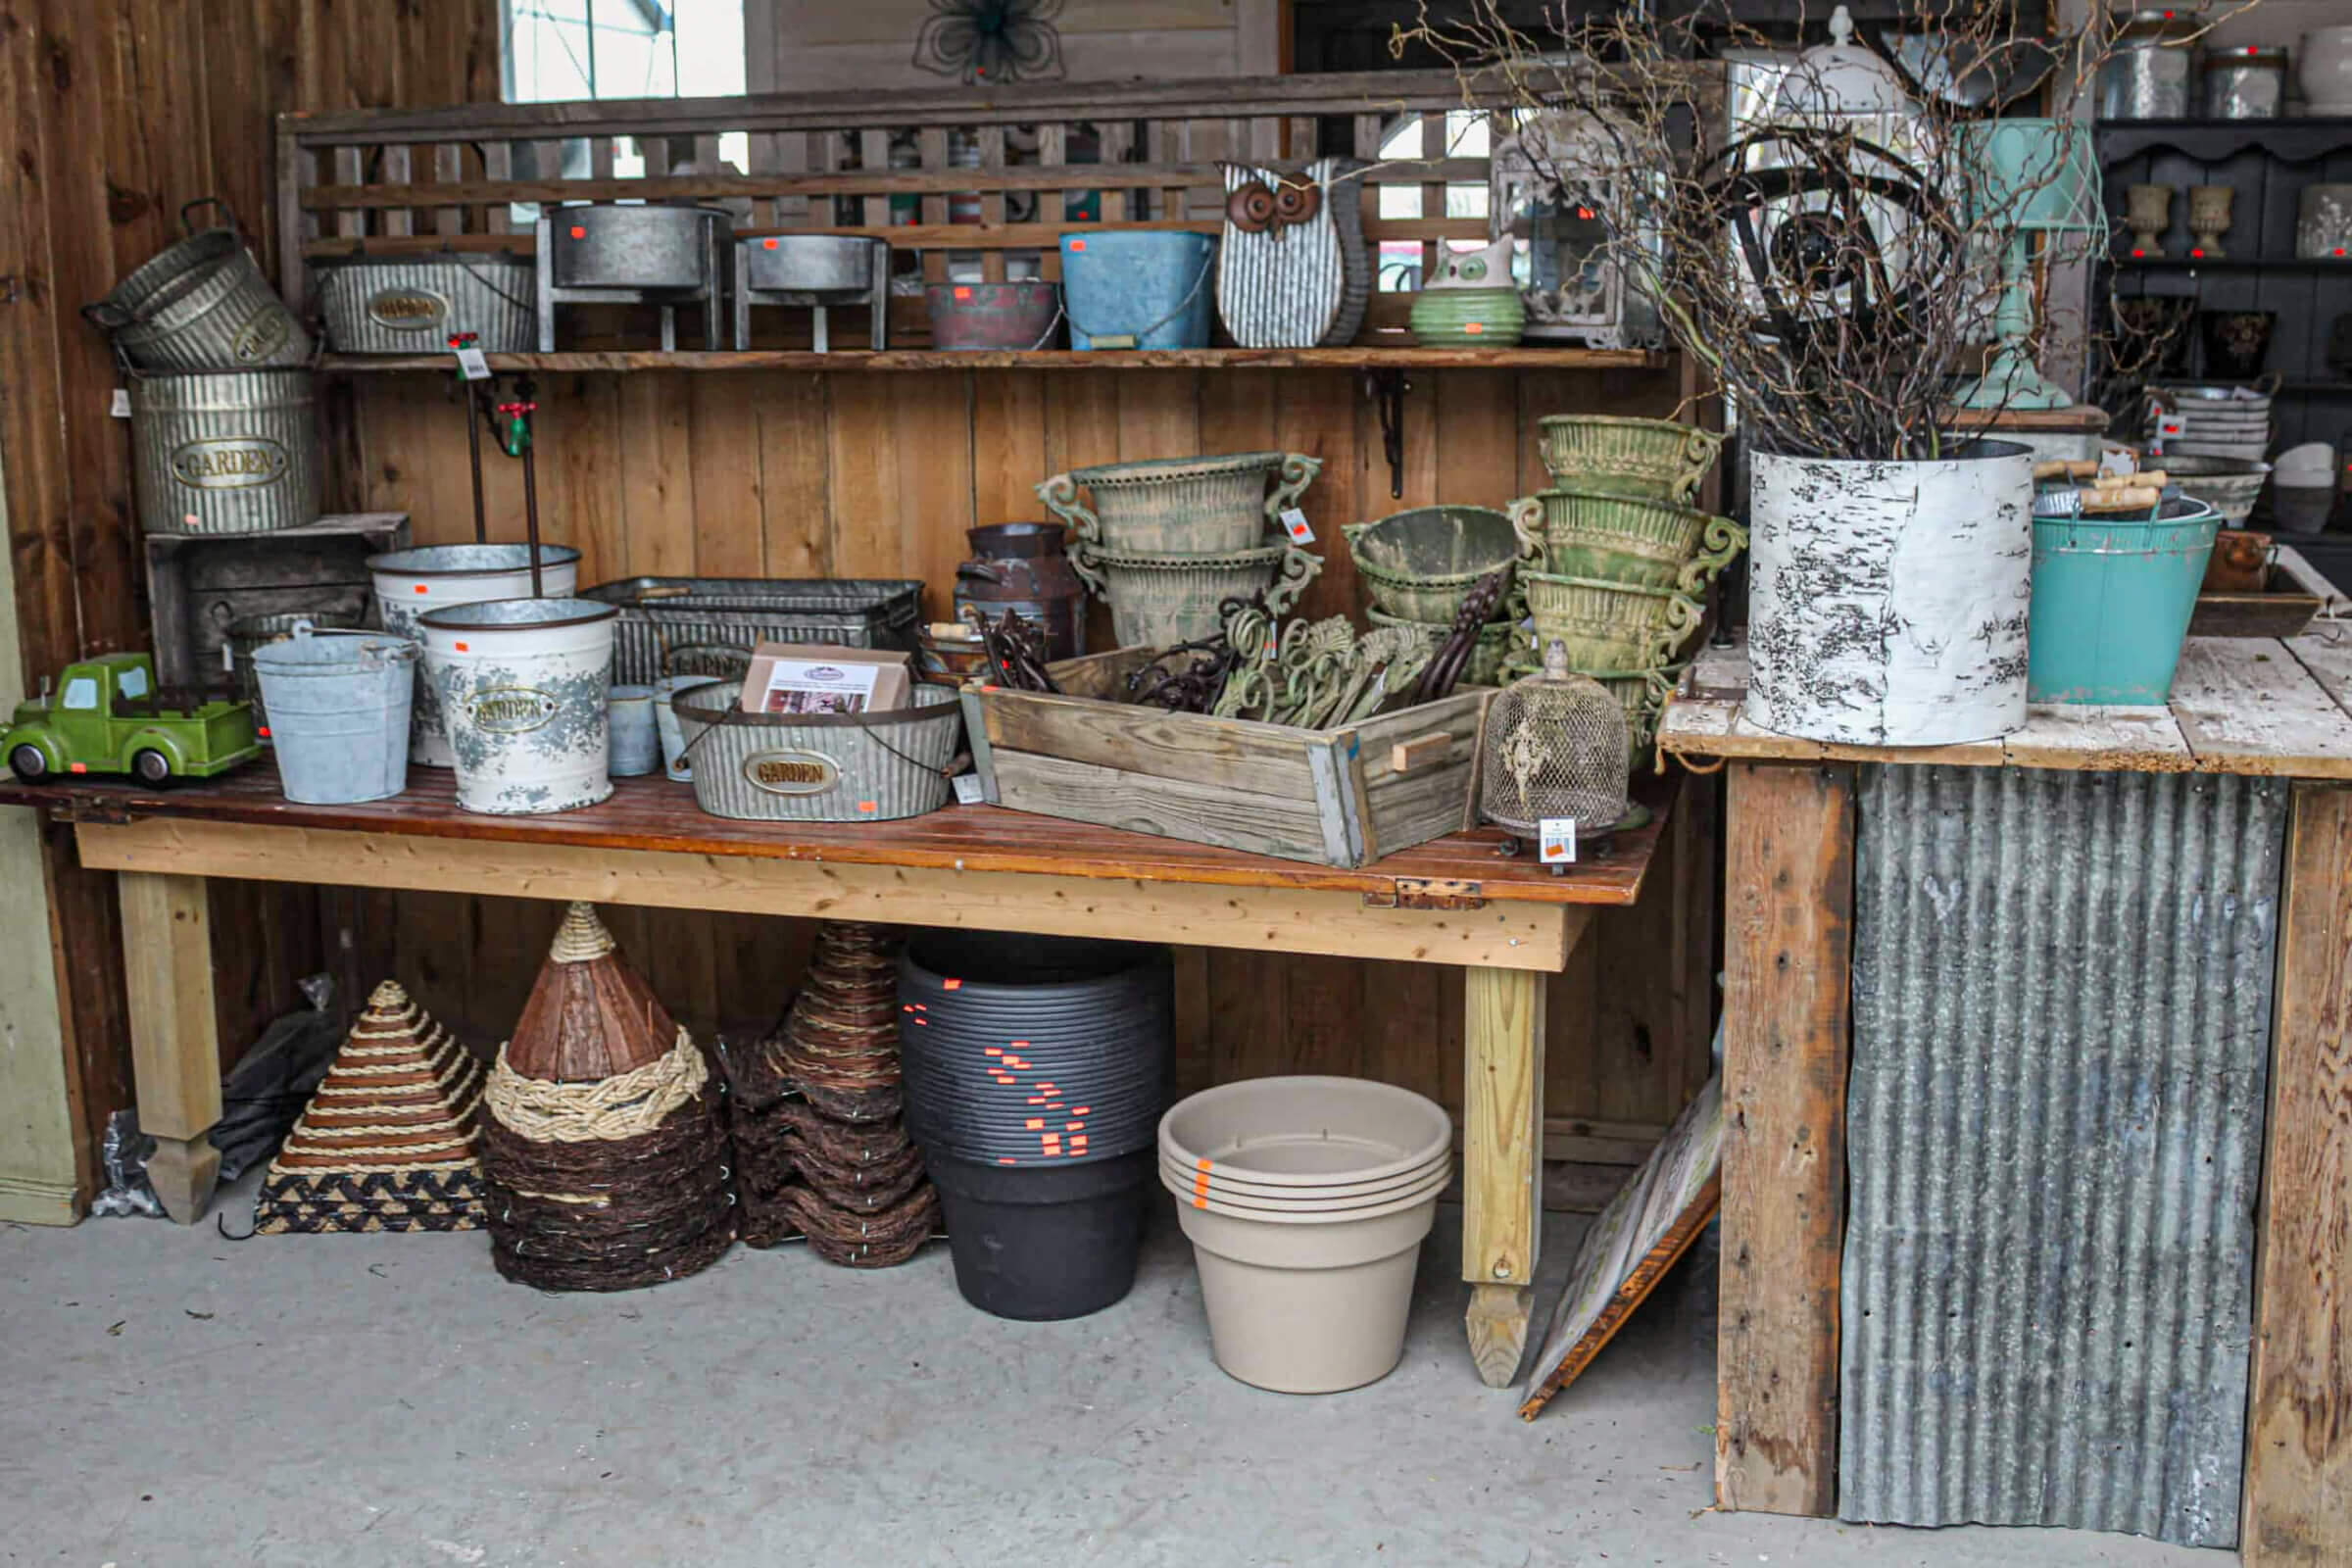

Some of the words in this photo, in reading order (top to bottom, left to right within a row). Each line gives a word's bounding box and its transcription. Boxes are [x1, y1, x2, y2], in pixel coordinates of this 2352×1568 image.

[187, 449, 273, 478] GARDEN
[476, 697, 542, 722] GARDEN
[759, 760, 824, 783] GARDEN
